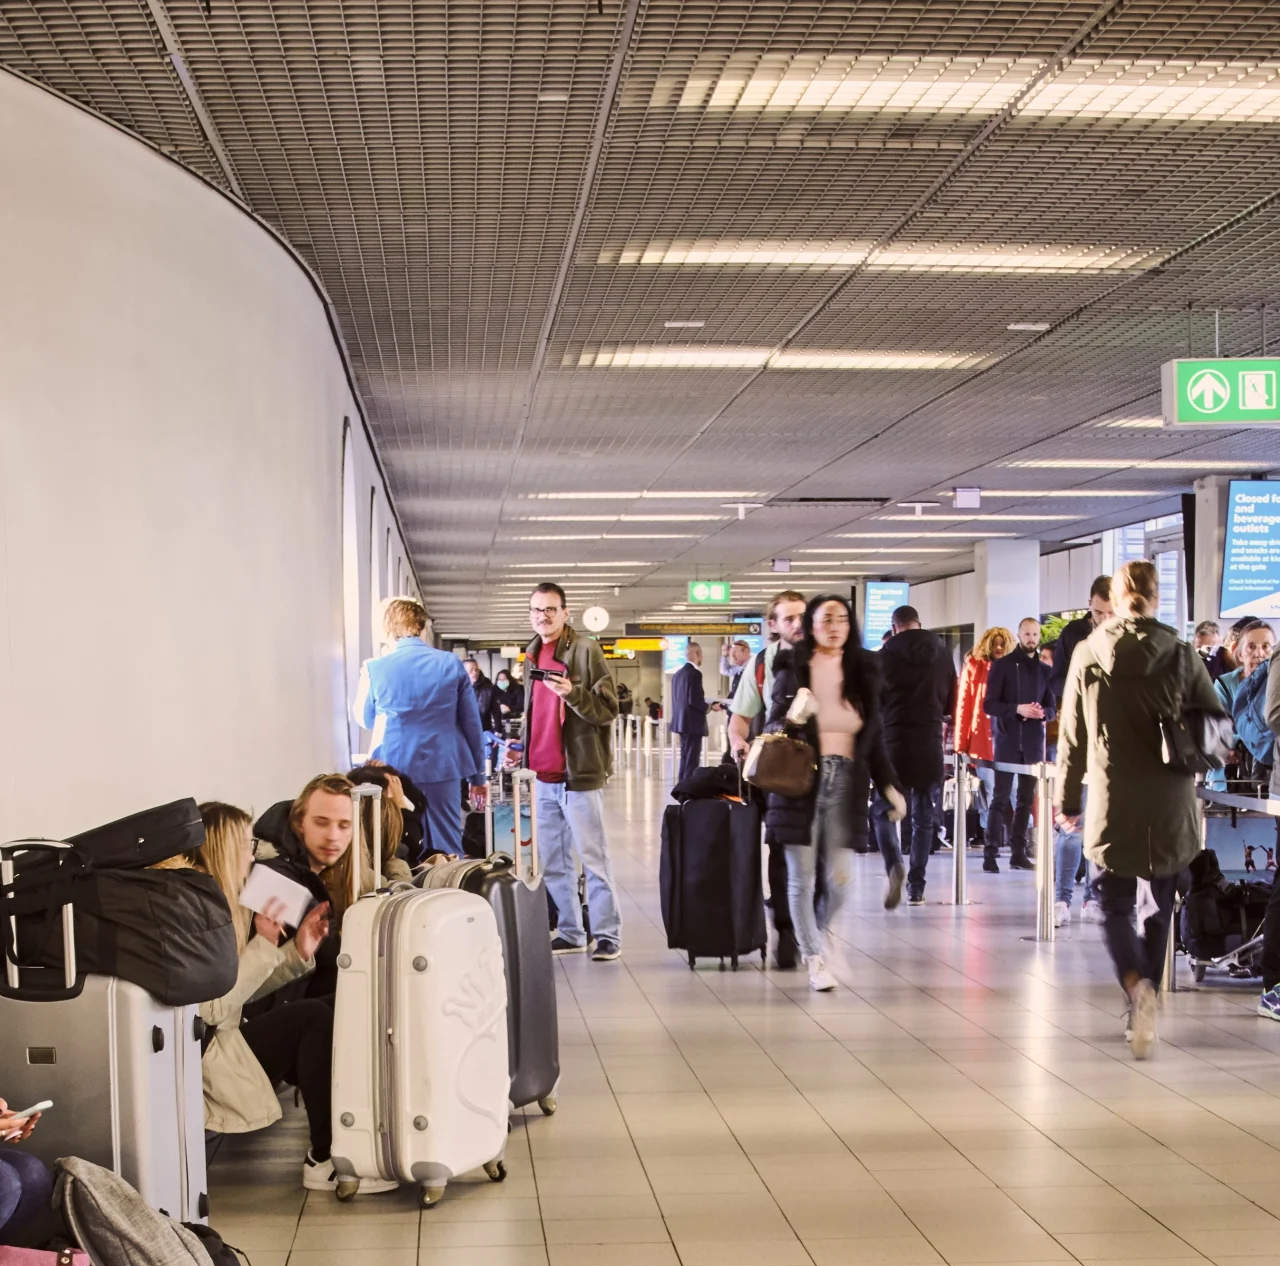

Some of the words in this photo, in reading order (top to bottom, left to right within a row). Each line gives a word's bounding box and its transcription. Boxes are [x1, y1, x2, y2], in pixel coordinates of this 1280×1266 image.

[1235, 493, 1270, 503] Closed
[1234, 504, 1255, 513] and
[1232, 524, 1269, 533] outlets
